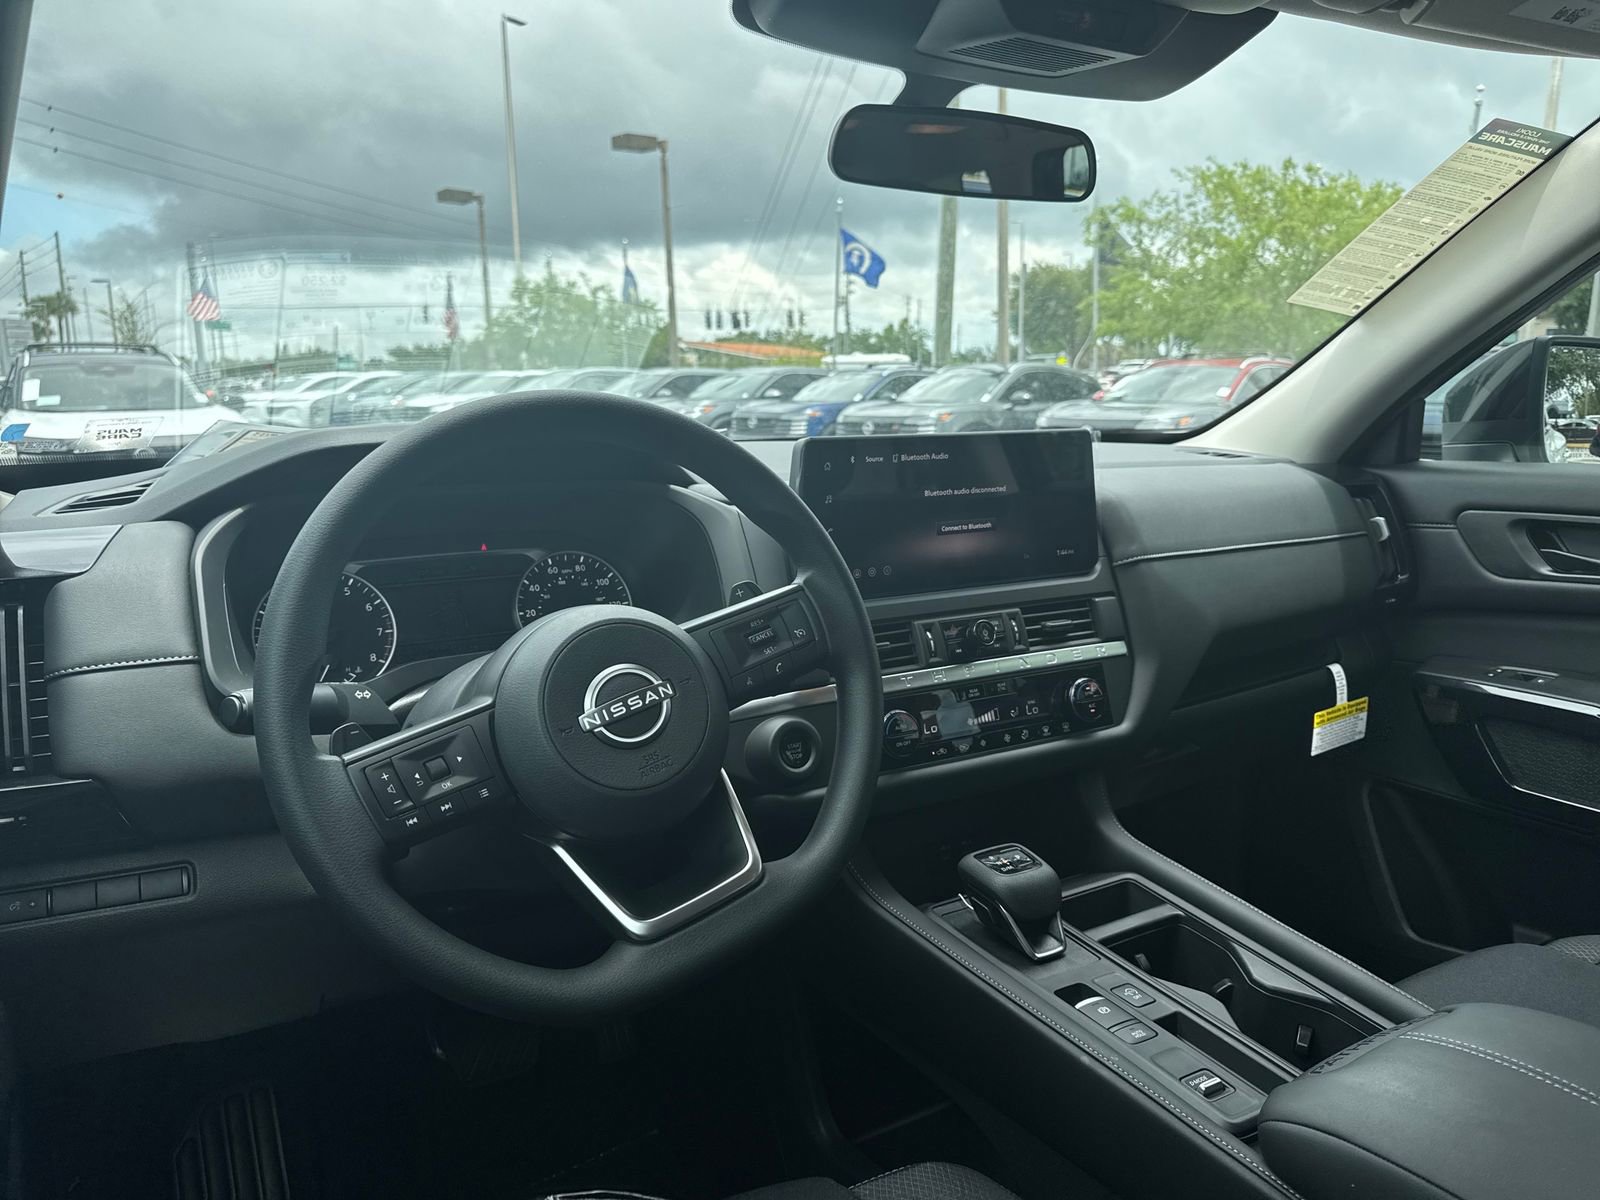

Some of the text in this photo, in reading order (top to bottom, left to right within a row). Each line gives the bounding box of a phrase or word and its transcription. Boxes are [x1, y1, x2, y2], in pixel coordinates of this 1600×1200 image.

[865, 451, 949, 463] Source Bluetooth Audio
[924, 488, 953, 497] Bluetooth
[970, 485, 1007, 494] disconnected
[968, 522, 992, 530] Bluetooth
[547, 567, 558, 575] 60
[596, 578, 610, 586] 100
[344, 587, 350, 596] 5
[366, 603, 373, 611] 6
[525, 609, 537, 618] 20
[376, 627, 383, 636] 7
[752, 629, 774, 643] CANCEL
[369, 653, 377, 662] 8
[582, 682, 673, 730] NISSAN
[640, 758, 674, 777] AIRBAG
[441, 780, 453, 790] OK
